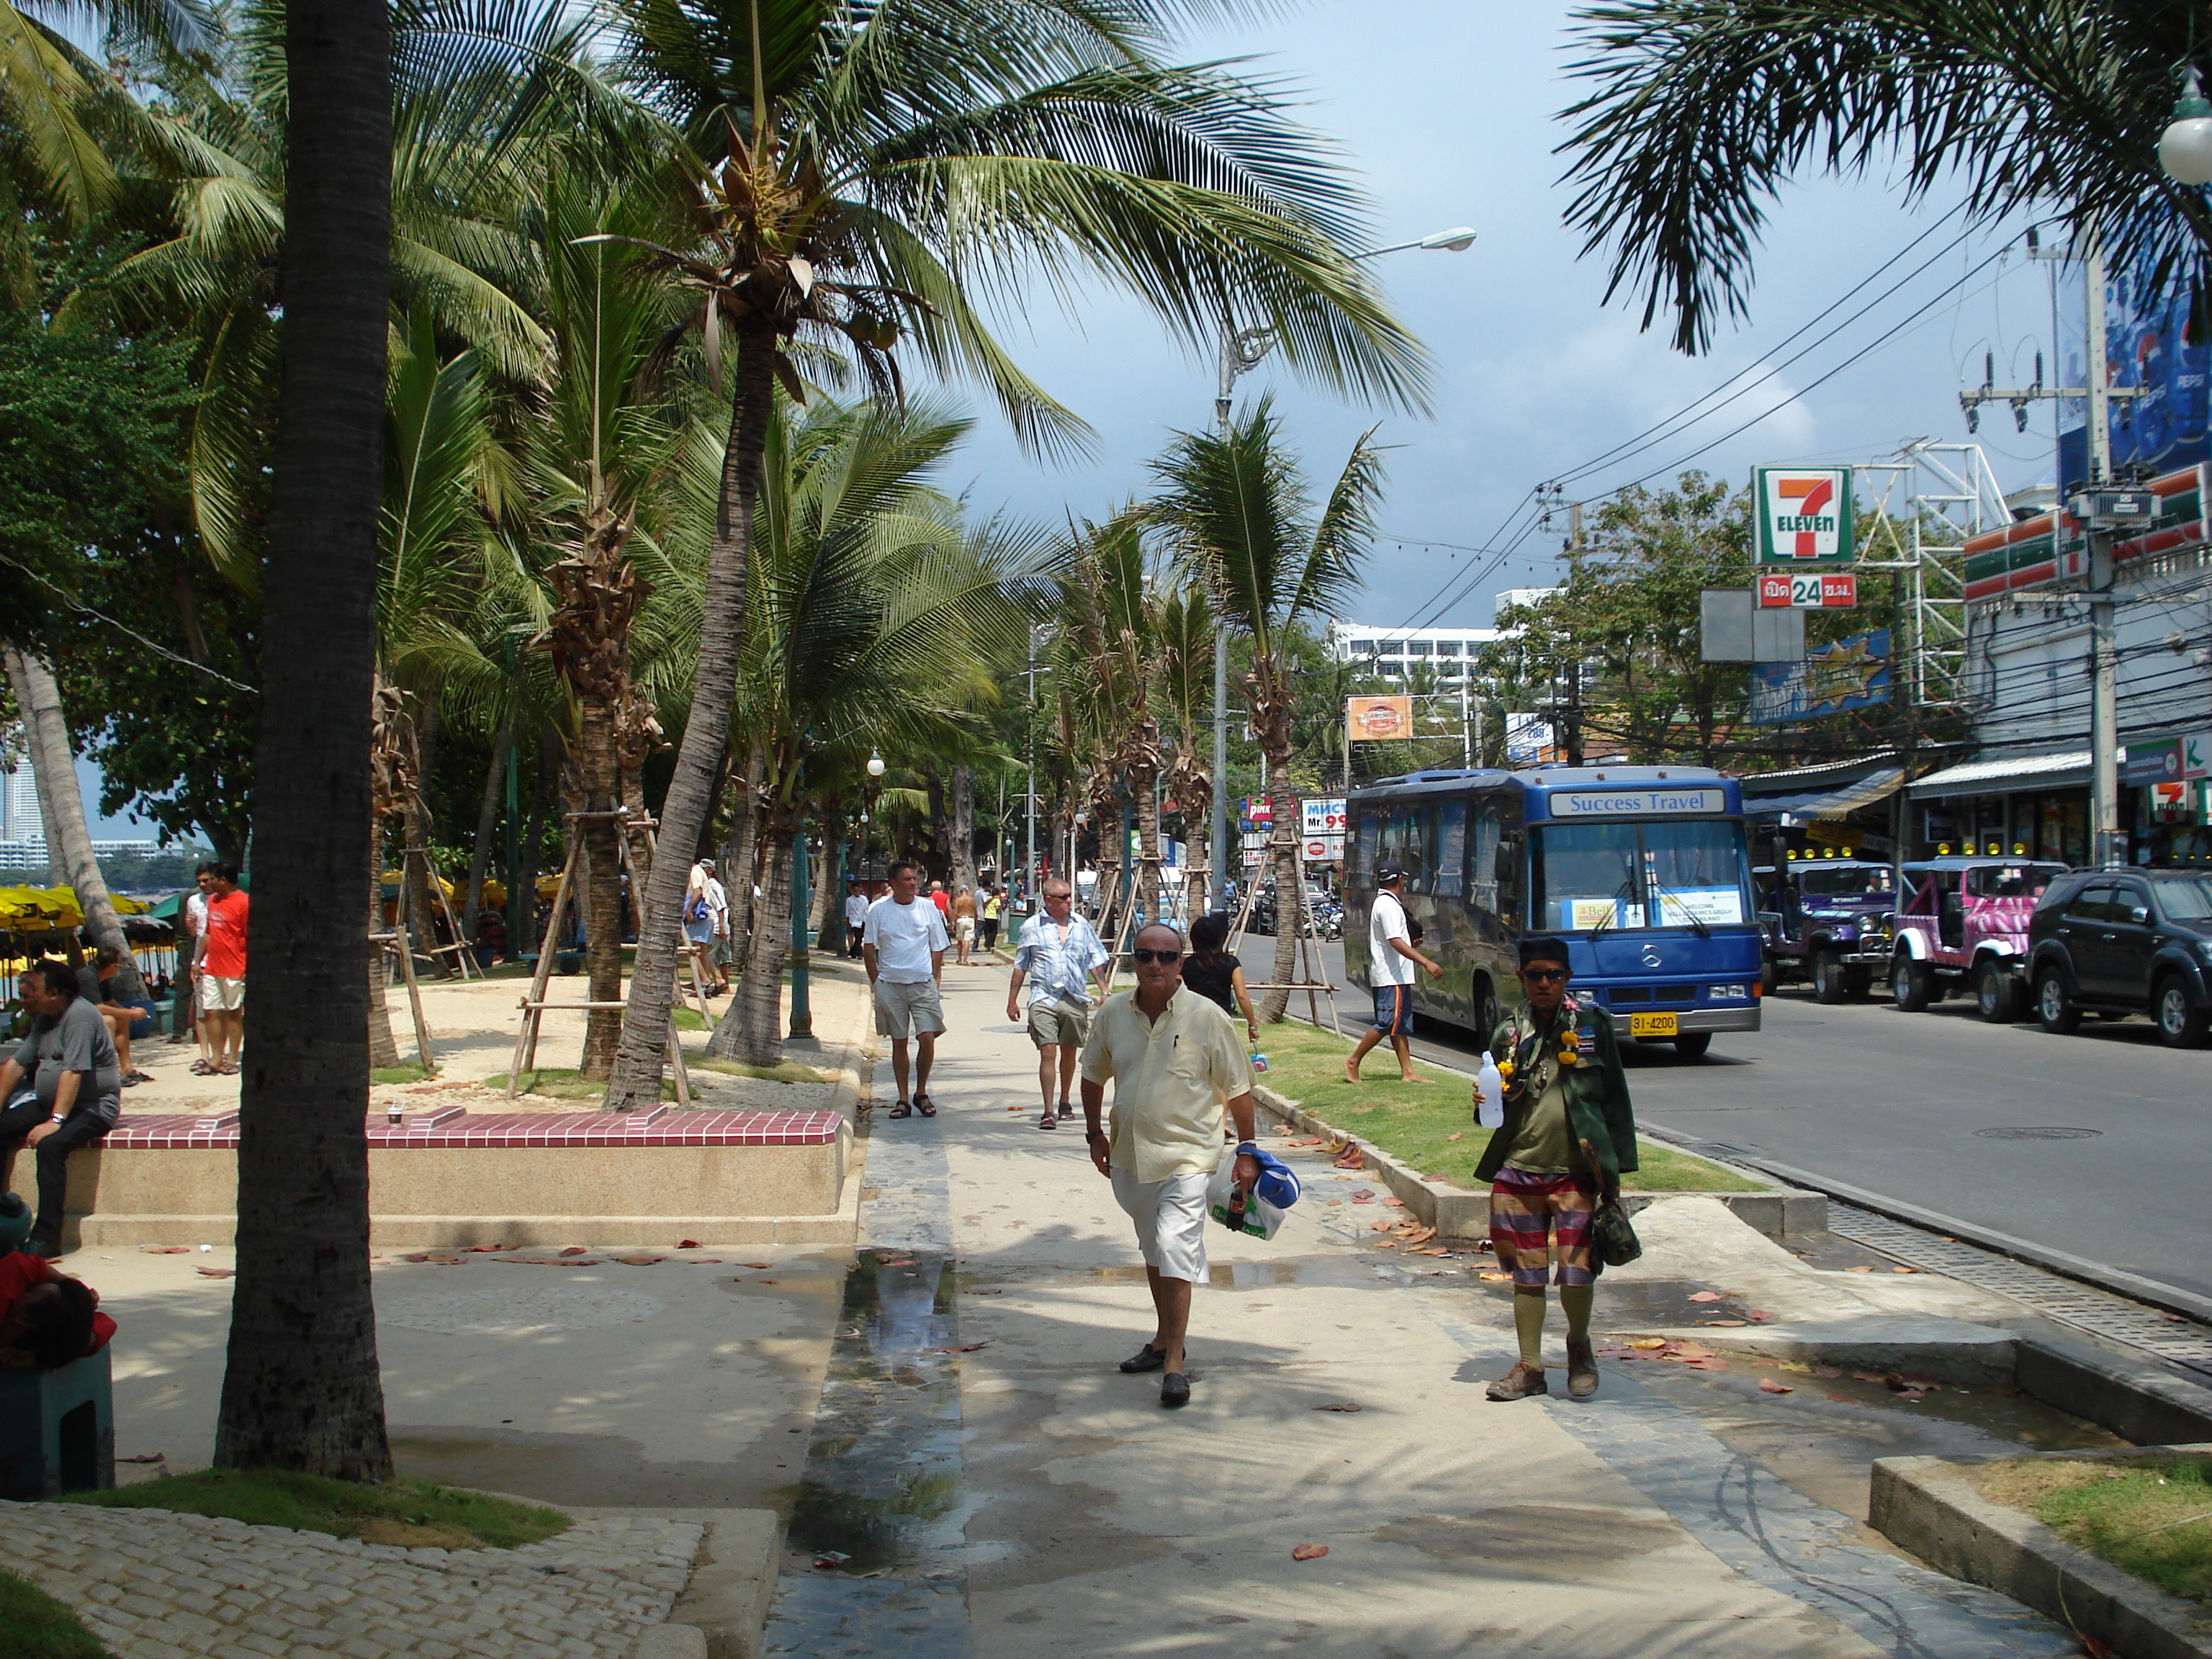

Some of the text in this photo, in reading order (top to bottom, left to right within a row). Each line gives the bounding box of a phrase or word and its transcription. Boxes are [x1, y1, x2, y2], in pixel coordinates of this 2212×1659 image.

[2177, 374, 2205, 388] PEPSI
[2141, 383, 2167, 411] PEPSI
[1779, 479, 1833, 557] 7
[1765, 581, 1789, 598] เปิด
[1792, 580, 1821, 603] 24
[1570, 792, 1704, 812] Success Travel
[1249, 805, 1272, 819] PINK
[1308, 818, 1323, 827] Mr.
[1588, 906, 1610, 916] Bell
[1633, 1017, 1674, 1029] 31-4200
